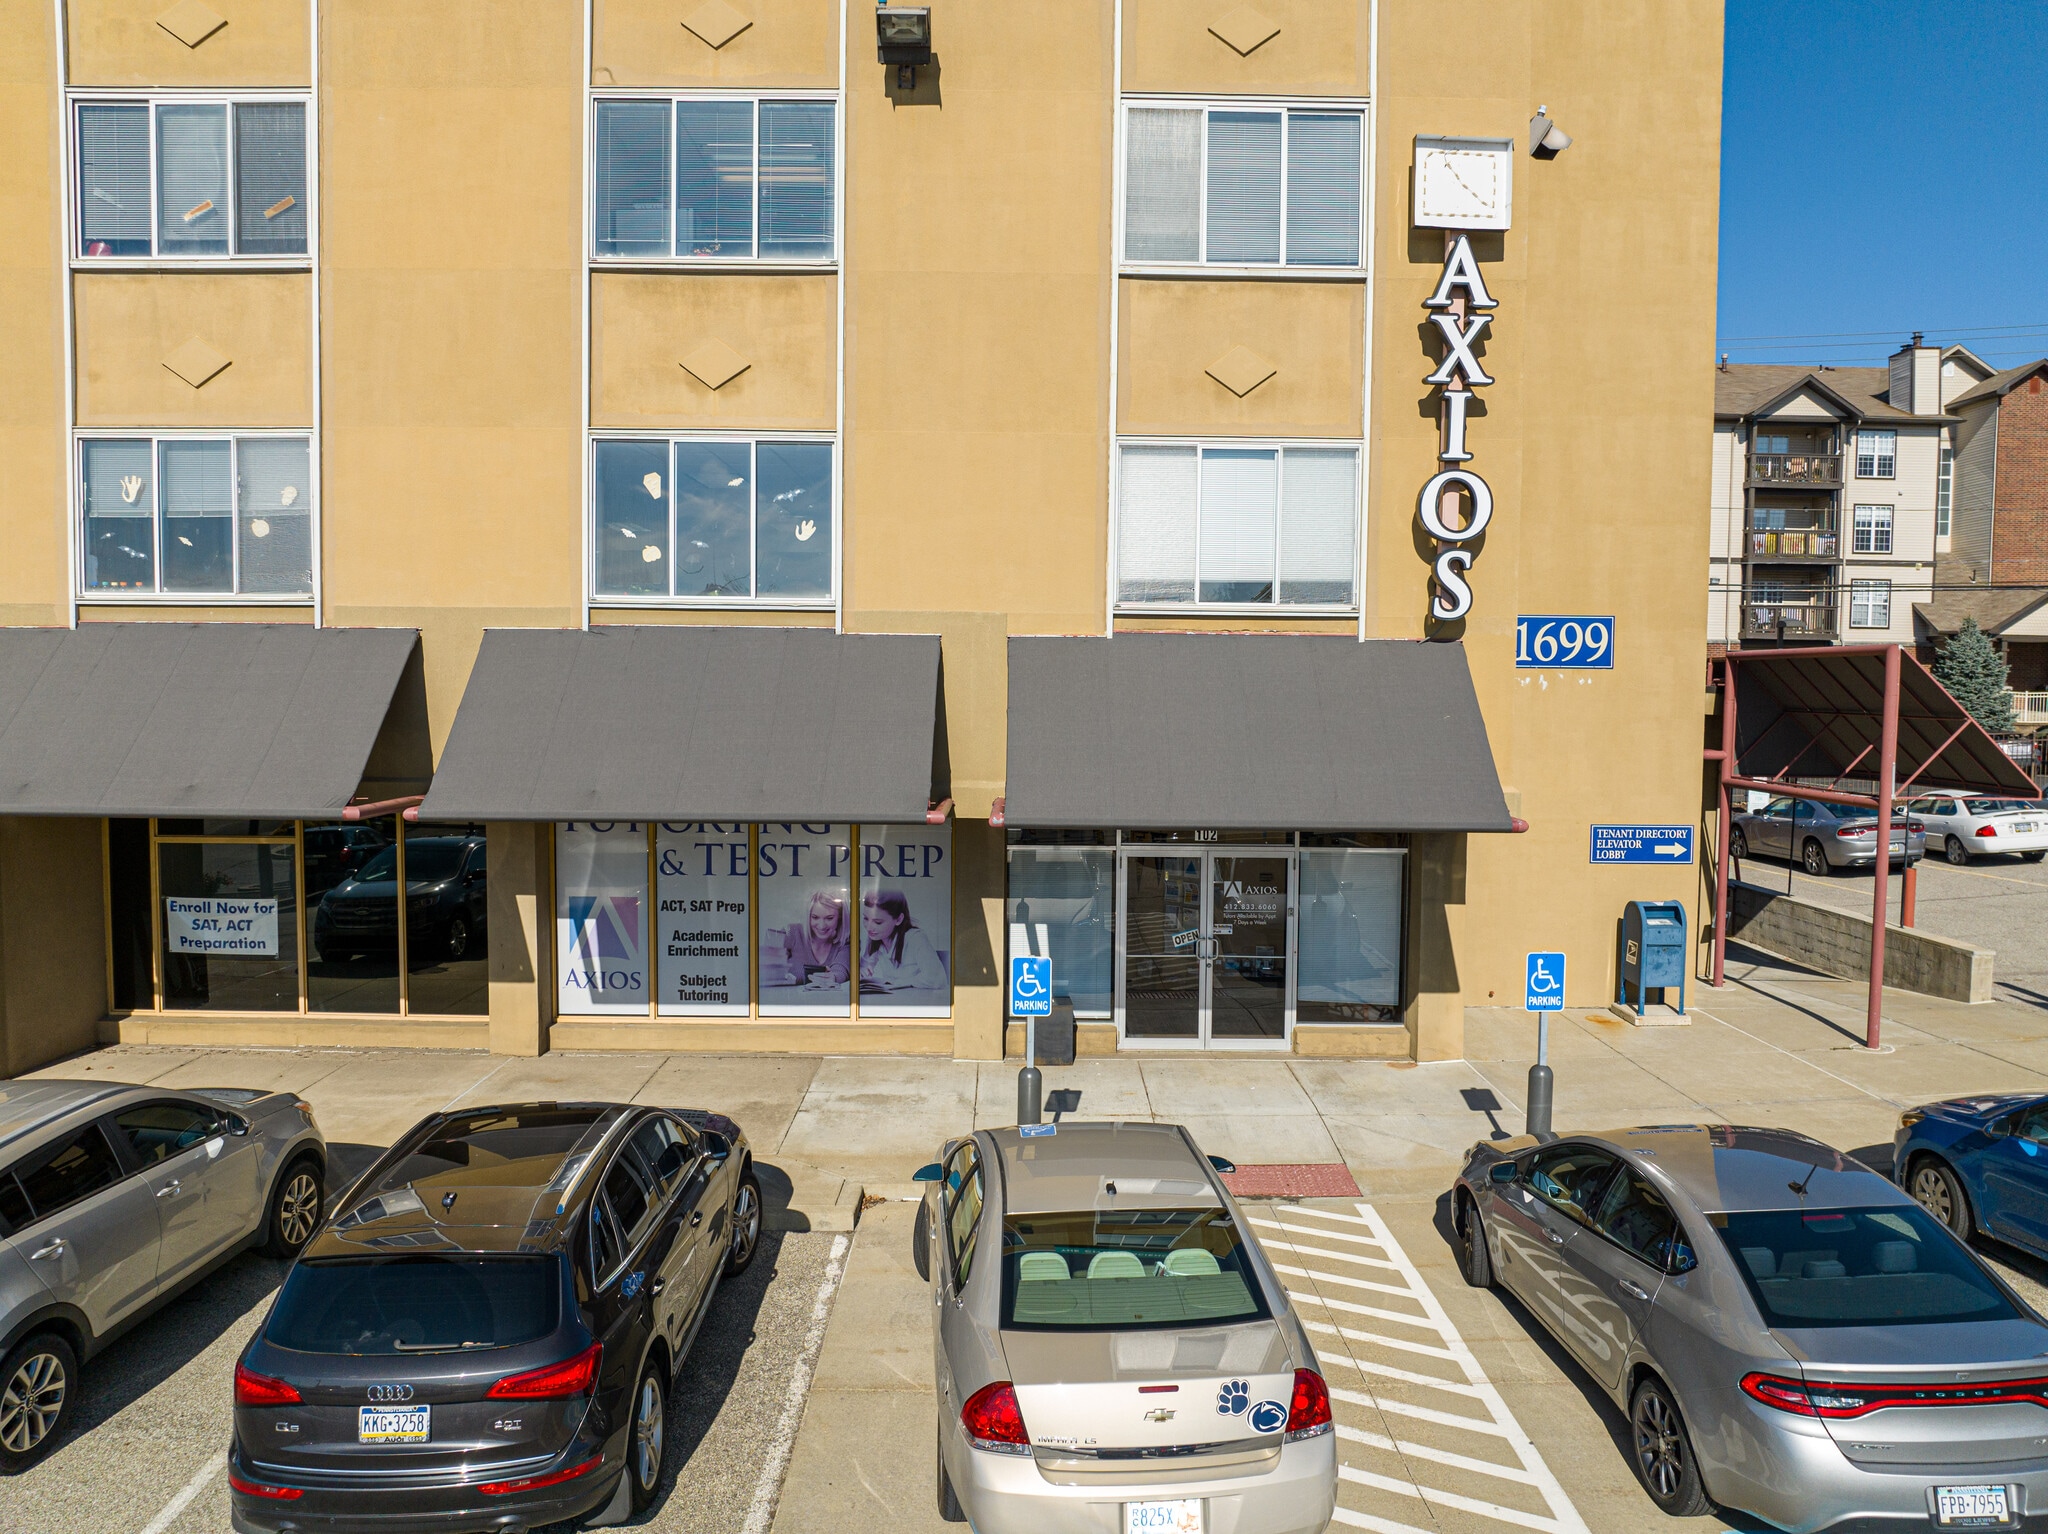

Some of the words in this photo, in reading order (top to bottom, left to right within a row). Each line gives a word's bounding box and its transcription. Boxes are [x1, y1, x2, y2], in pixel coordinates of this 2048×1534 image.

[1418, 233, 1499, 622] AXIOS
[1515, 621, 1609, 663] 1699
[1597, 829, 1634, 839] TENANT
[1635, 830, 1688, 839] DIRECTORY
[1596, 840, 1643, 849] ELEVATOR
[659, 849, 688, 876] &
[694, 843, 810, 877] TEST
[828, 844, 944, 878] PREP
[1596, 850, 1627, 860] LOBBY
[1245, 885, 1278, 895] AXIOS
[169, 900, 212, 914] Enroll
[216, 902, 250, 914] Now
[253, 902, 275, 915] for
[661, 900, 687, 914] ACT,
[690, 900, 713, 912] SAT
[716, 900, 746, 915] Prep
[191, 918, 222, 933] SAT,
[226, 919, 253, 932] ACT
[180, 936, 267, 951] Preparation
[672, 929, 734, 943] Academic
[1174, 931, 1199, 945] OPEN
[667, 944, 739, 958] Enrichment
[565, 967, 642, 990] AXIOS
[679, 974, 727, 989] Subject
[678, 989, 729, 1004] Tutoring
[1528, 996, 1562, 1006] PARKING
[1014, 1000, 1049, 1011] PARKING
[1140, 1506, 1174, 1527] 825X
